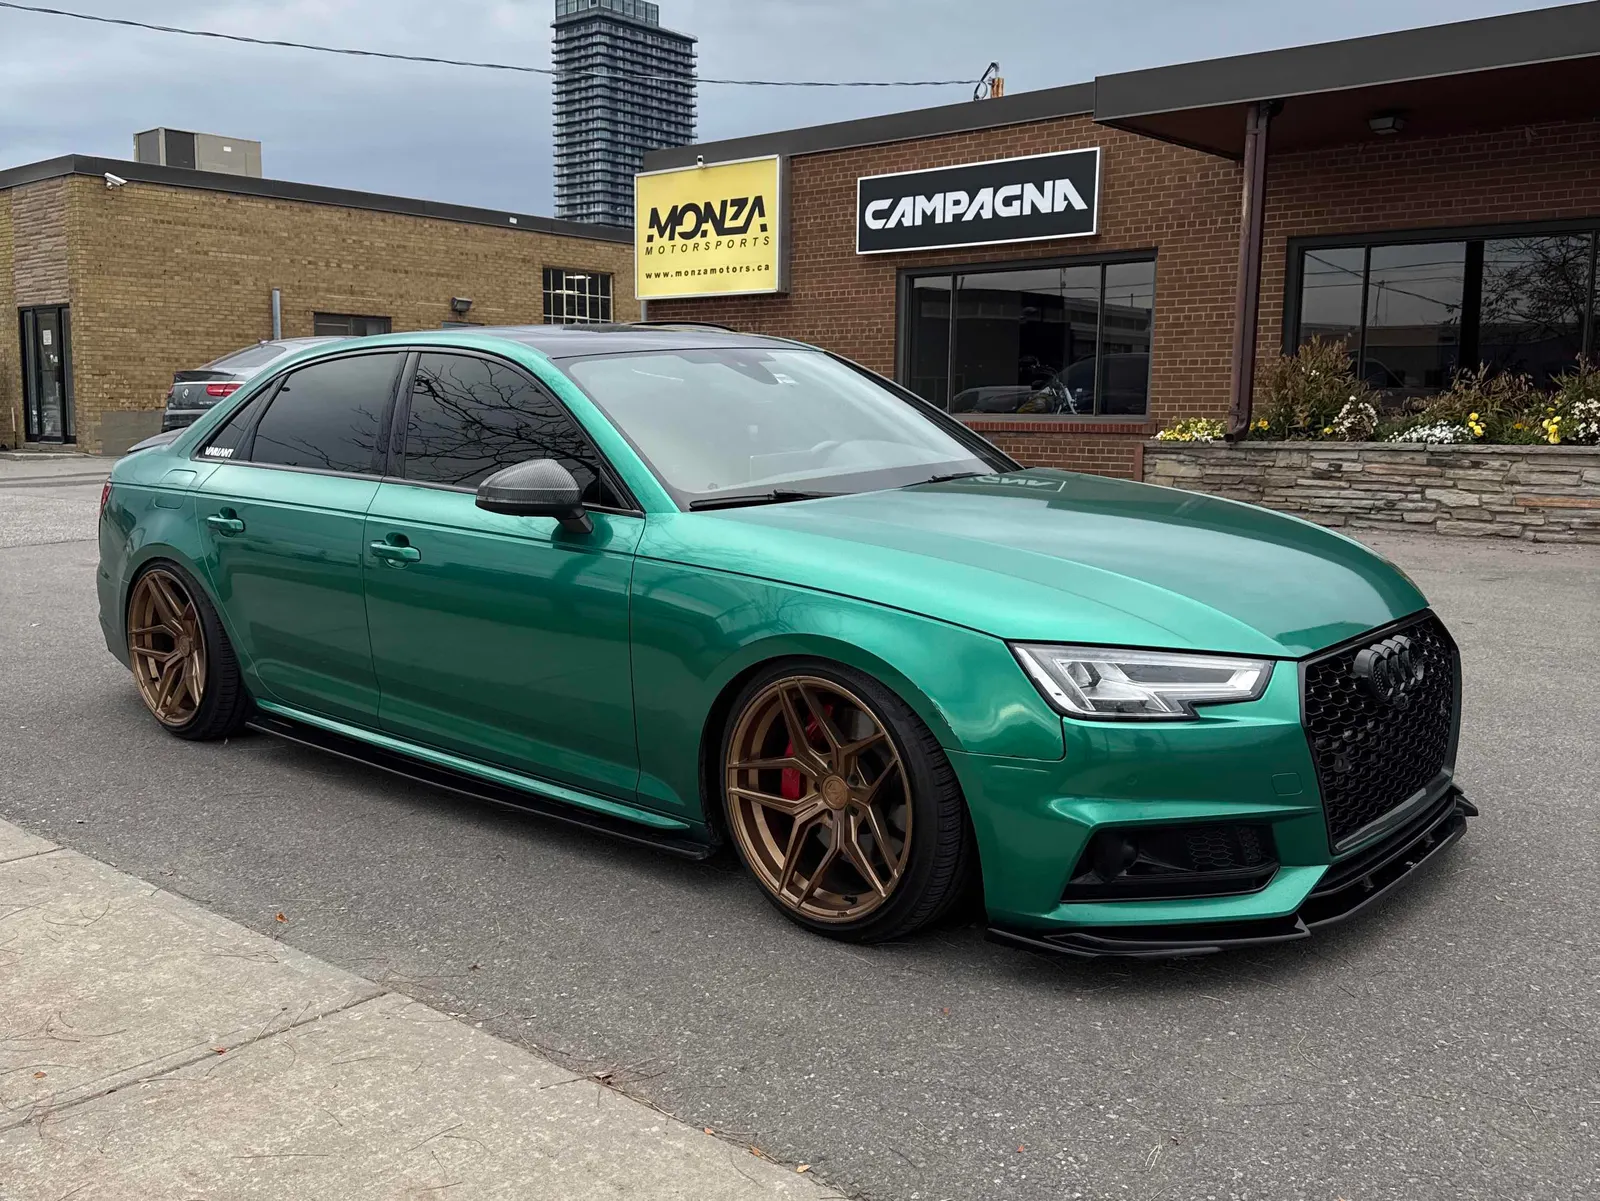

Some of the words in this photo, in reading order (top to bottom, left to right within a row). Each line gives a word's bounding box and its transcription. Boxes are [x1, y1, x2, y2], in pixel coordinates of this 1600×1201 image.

[646, 195, 768, 243] MONZA
[864, 178, 1089, 230] CAMPAGNA
[645, 235, 770, 256] MOTORSPORTS
[645, 264, 770, 279] www.monzamotors.ca
